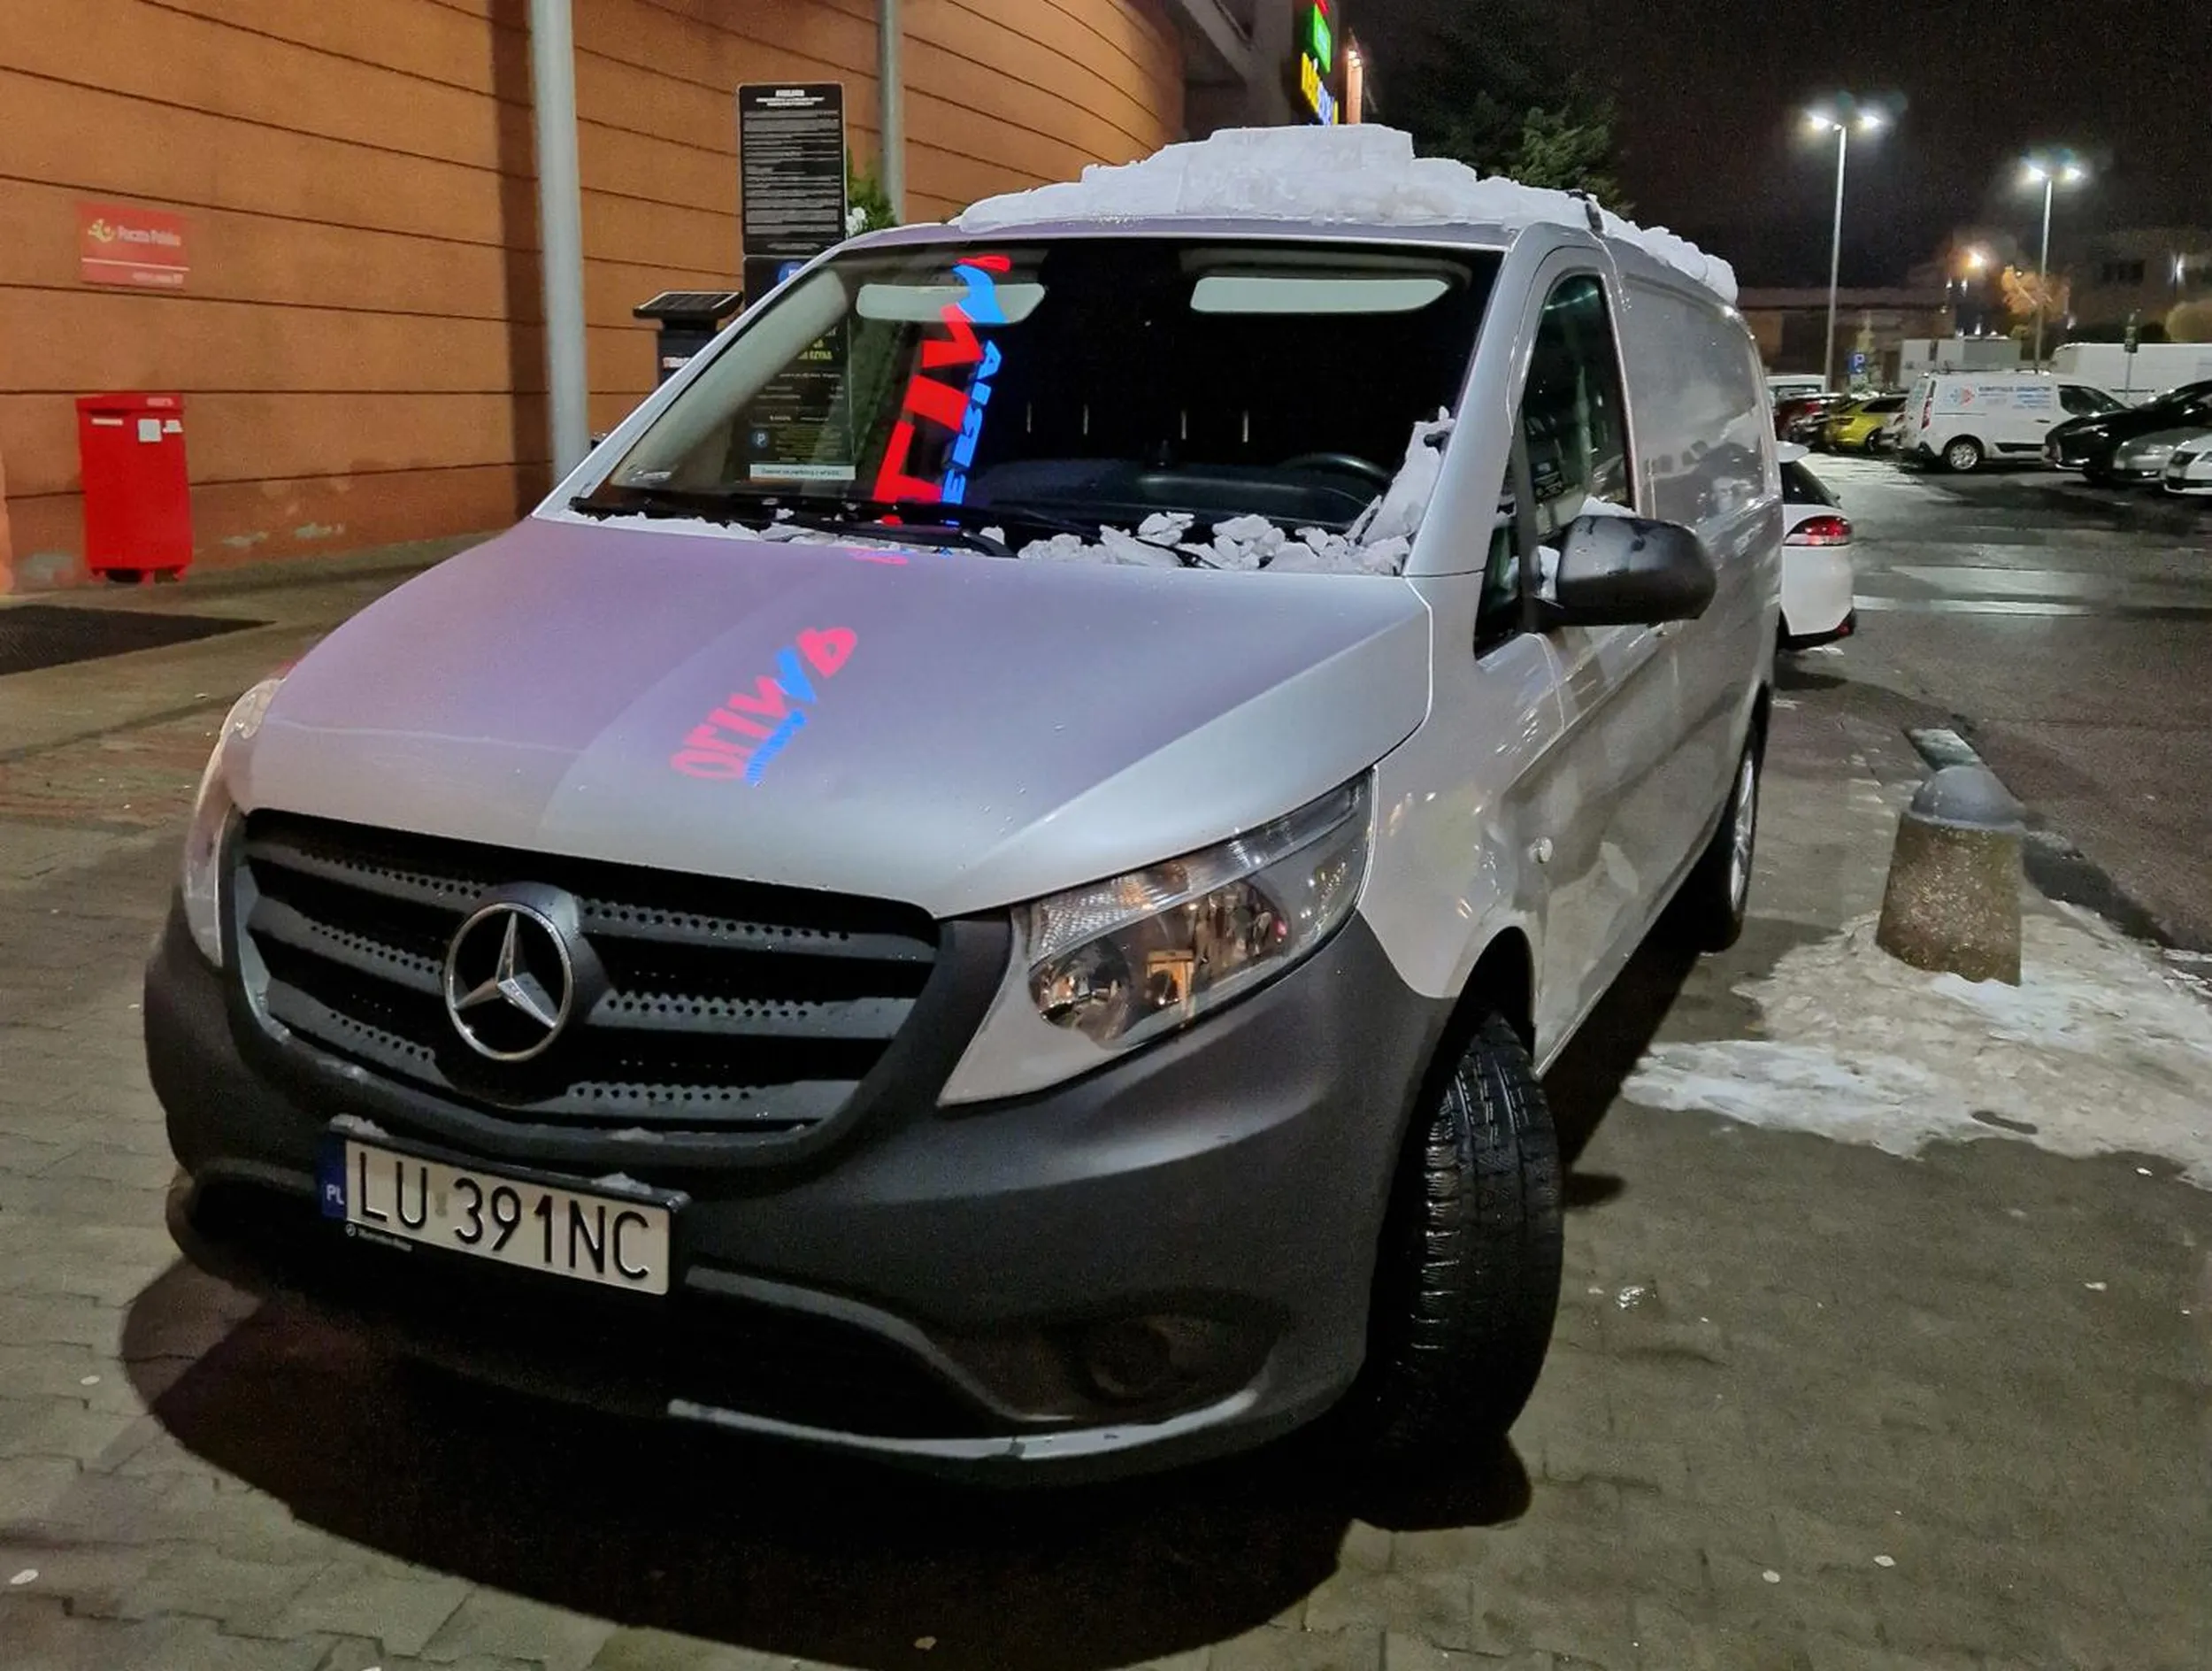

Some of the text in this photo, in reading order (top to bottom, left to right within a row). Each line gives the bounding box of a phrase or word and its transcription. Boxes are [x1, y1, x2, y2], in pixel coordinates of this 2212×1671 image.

[326, 1183, 345, 1205] PL
[359, 1151, 650, 1281] LU 391NC
